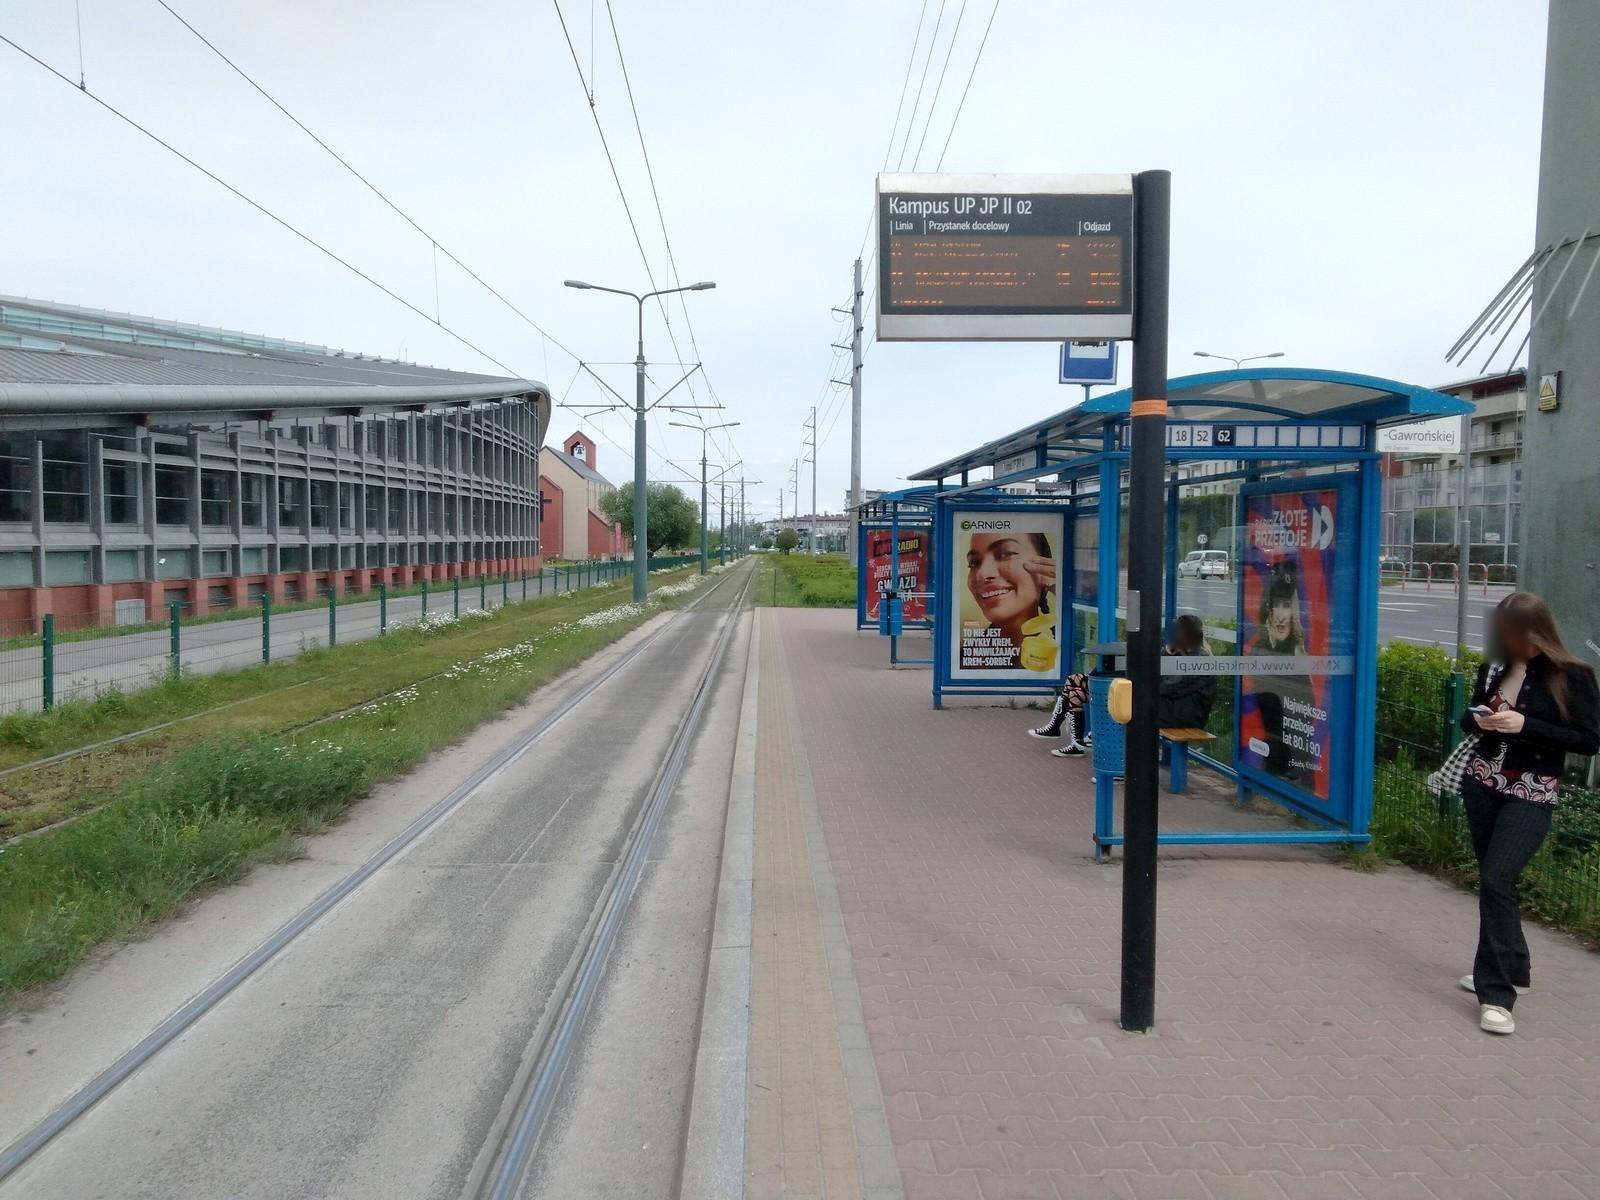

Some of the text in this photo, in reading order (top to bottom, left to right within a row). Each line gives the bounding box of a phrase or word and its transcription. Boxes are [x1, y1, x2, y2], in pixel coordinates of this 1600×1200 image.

[889, 197, 1032, 217] Kampus UP JP II 02
[895, 221, 914, 230] Linia
[928, 221, 1010, 233] Przystanek docelowy
[1083, 221, 1111, 232] Odjazd
[1175, 430, 1187, 442] 18
[1196, 430, 1208, 442] 52
[1217, 430, 1230, 442] 62
[1273, 509, 1308, 527] ZŁOTE
[960, 520, 1011, 530] GARNIER
[1255, 529, 1307, 547] PRZEBOJE
[877, 575, 917, 592] GWAZD
[963, 628, 1002, 637] TO NIE JEST
[963, 638, 991, 647] ZWYKŁY
[963, 648, 972, 656] TO
[963, 657, 1013, 666] KREM-SORBET.
[1283, 696, 1327, 721] Największe
[1282, 716, 1315, 737] przeboje
[1282, 730, 1292, 746] lat
[1293, 734, 1305, 751] 80.
[1309, 741, 1322, 758] 90.
